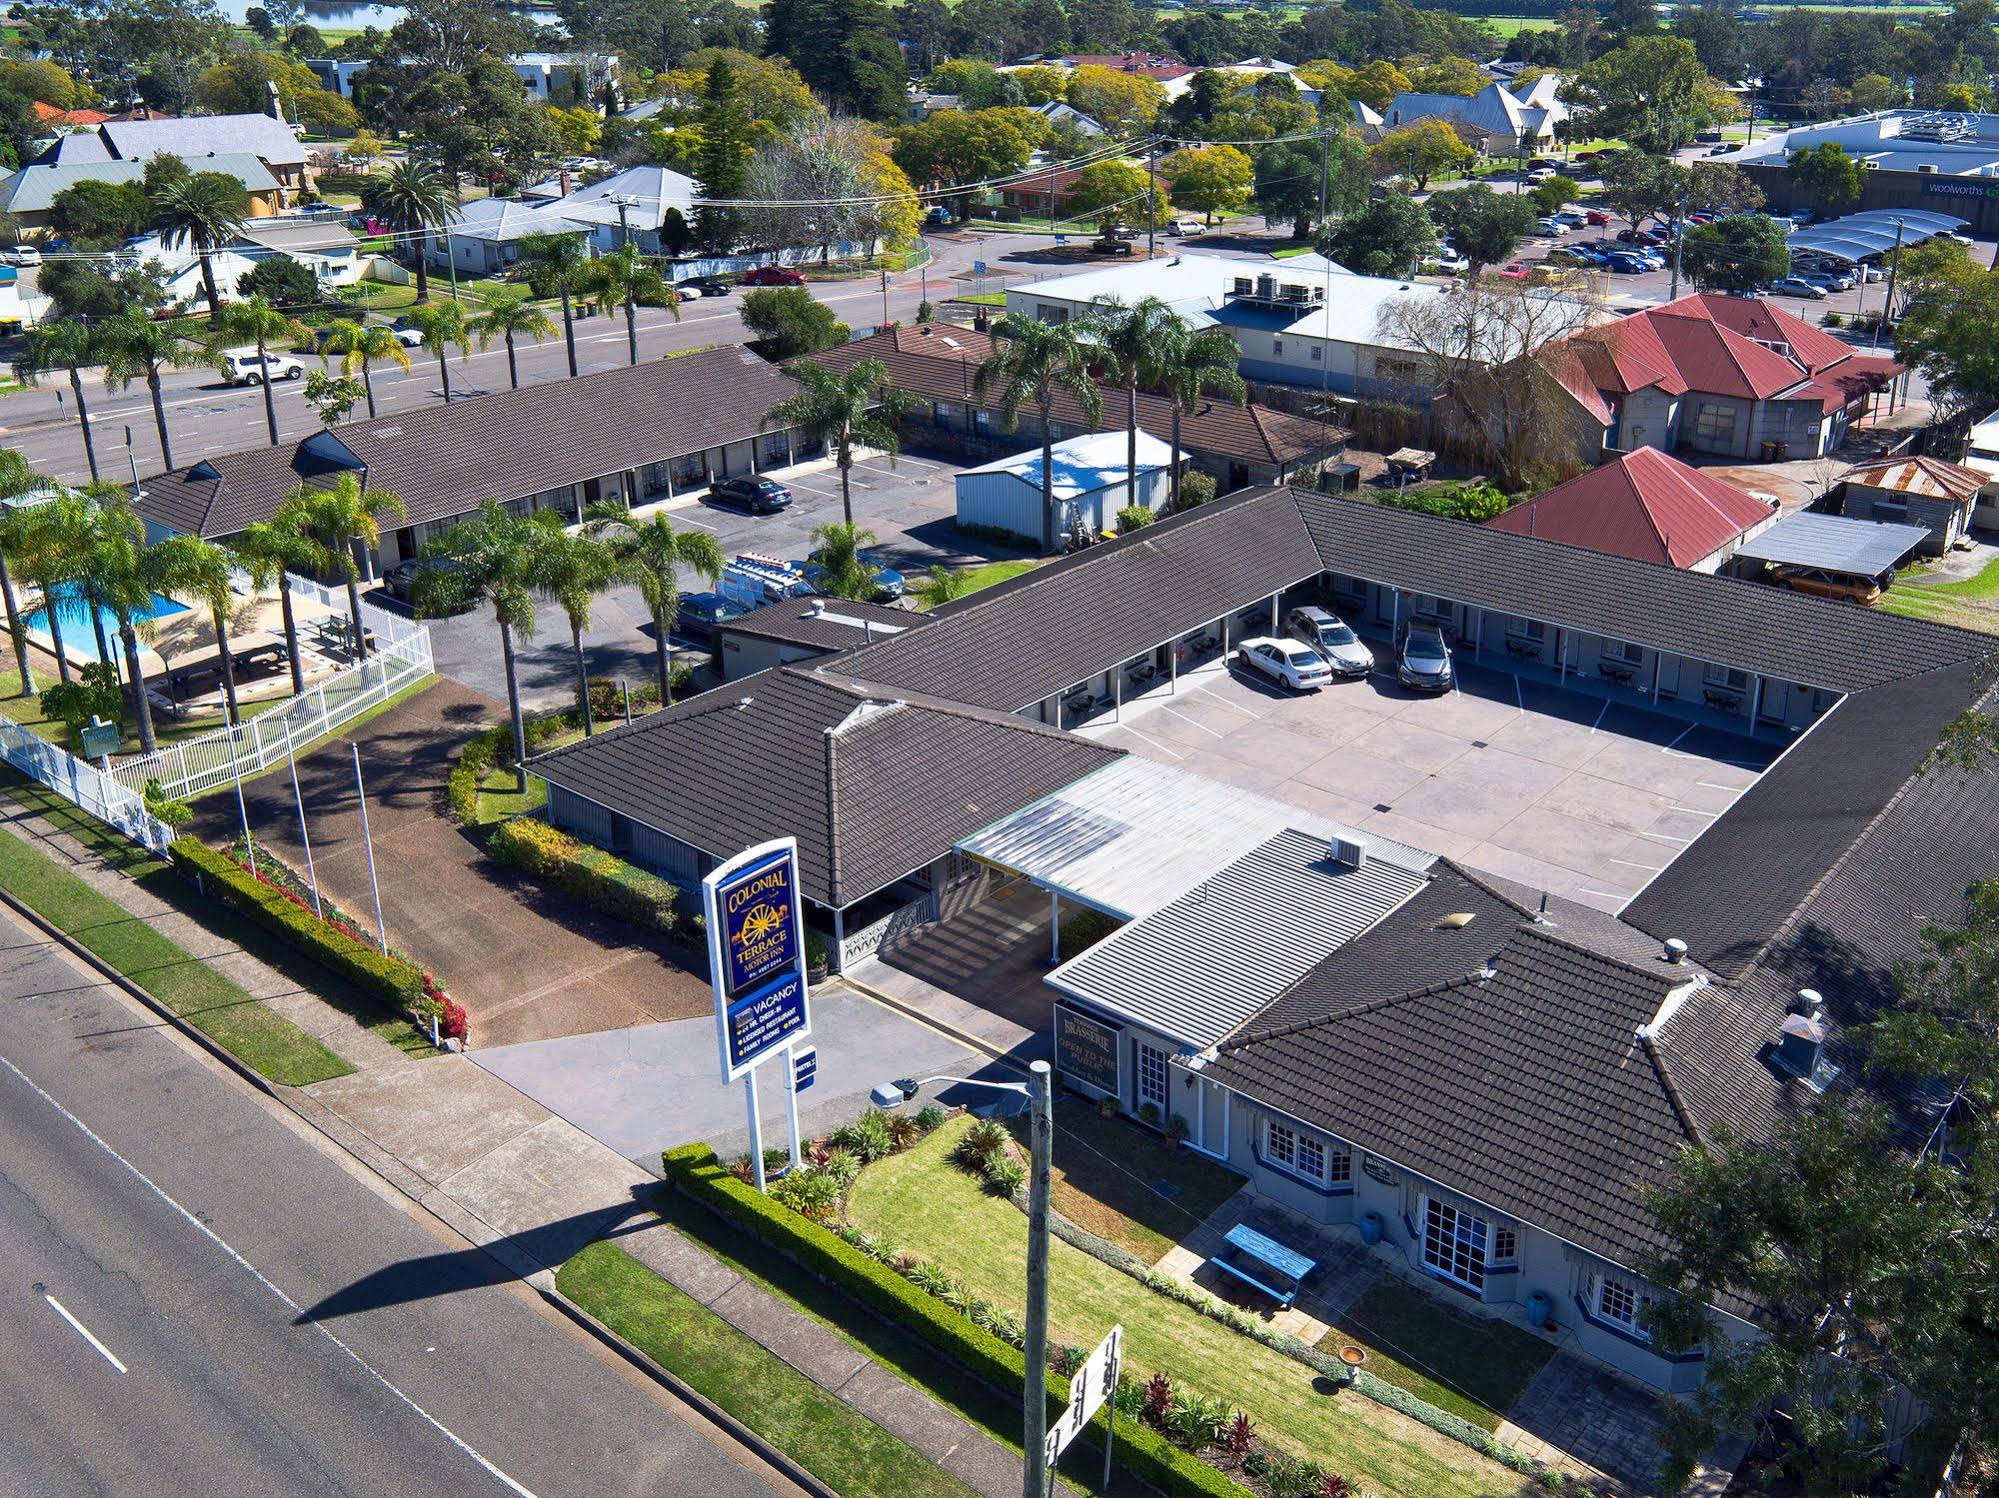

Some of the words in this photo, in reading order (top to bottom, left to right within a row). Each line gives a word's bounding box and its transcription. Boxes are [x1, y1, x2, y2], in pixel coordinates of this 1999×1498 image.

[729, 870, 787, 913] COLONIAL
[736, 930, 787, 964] TERRACE
[744, 954, 769, 973] MOTOR
[770, 945, 785, 959] INN
[753, 981, 798, 1014] VACANCY
[759, 1005, 782, 1023] CHECK-IN
[743, 1025, 766, 1044] LICENSED
[766, 1006, 796, 1031] RESTAURANT
[743, 1038, 761, 1054] FAMILY
[762, 1027, 780, 1042] ROOMS
[788, 1015, 801, 1027] POOL
[1064, 1019, 1110, 1053] BRASSERIE
